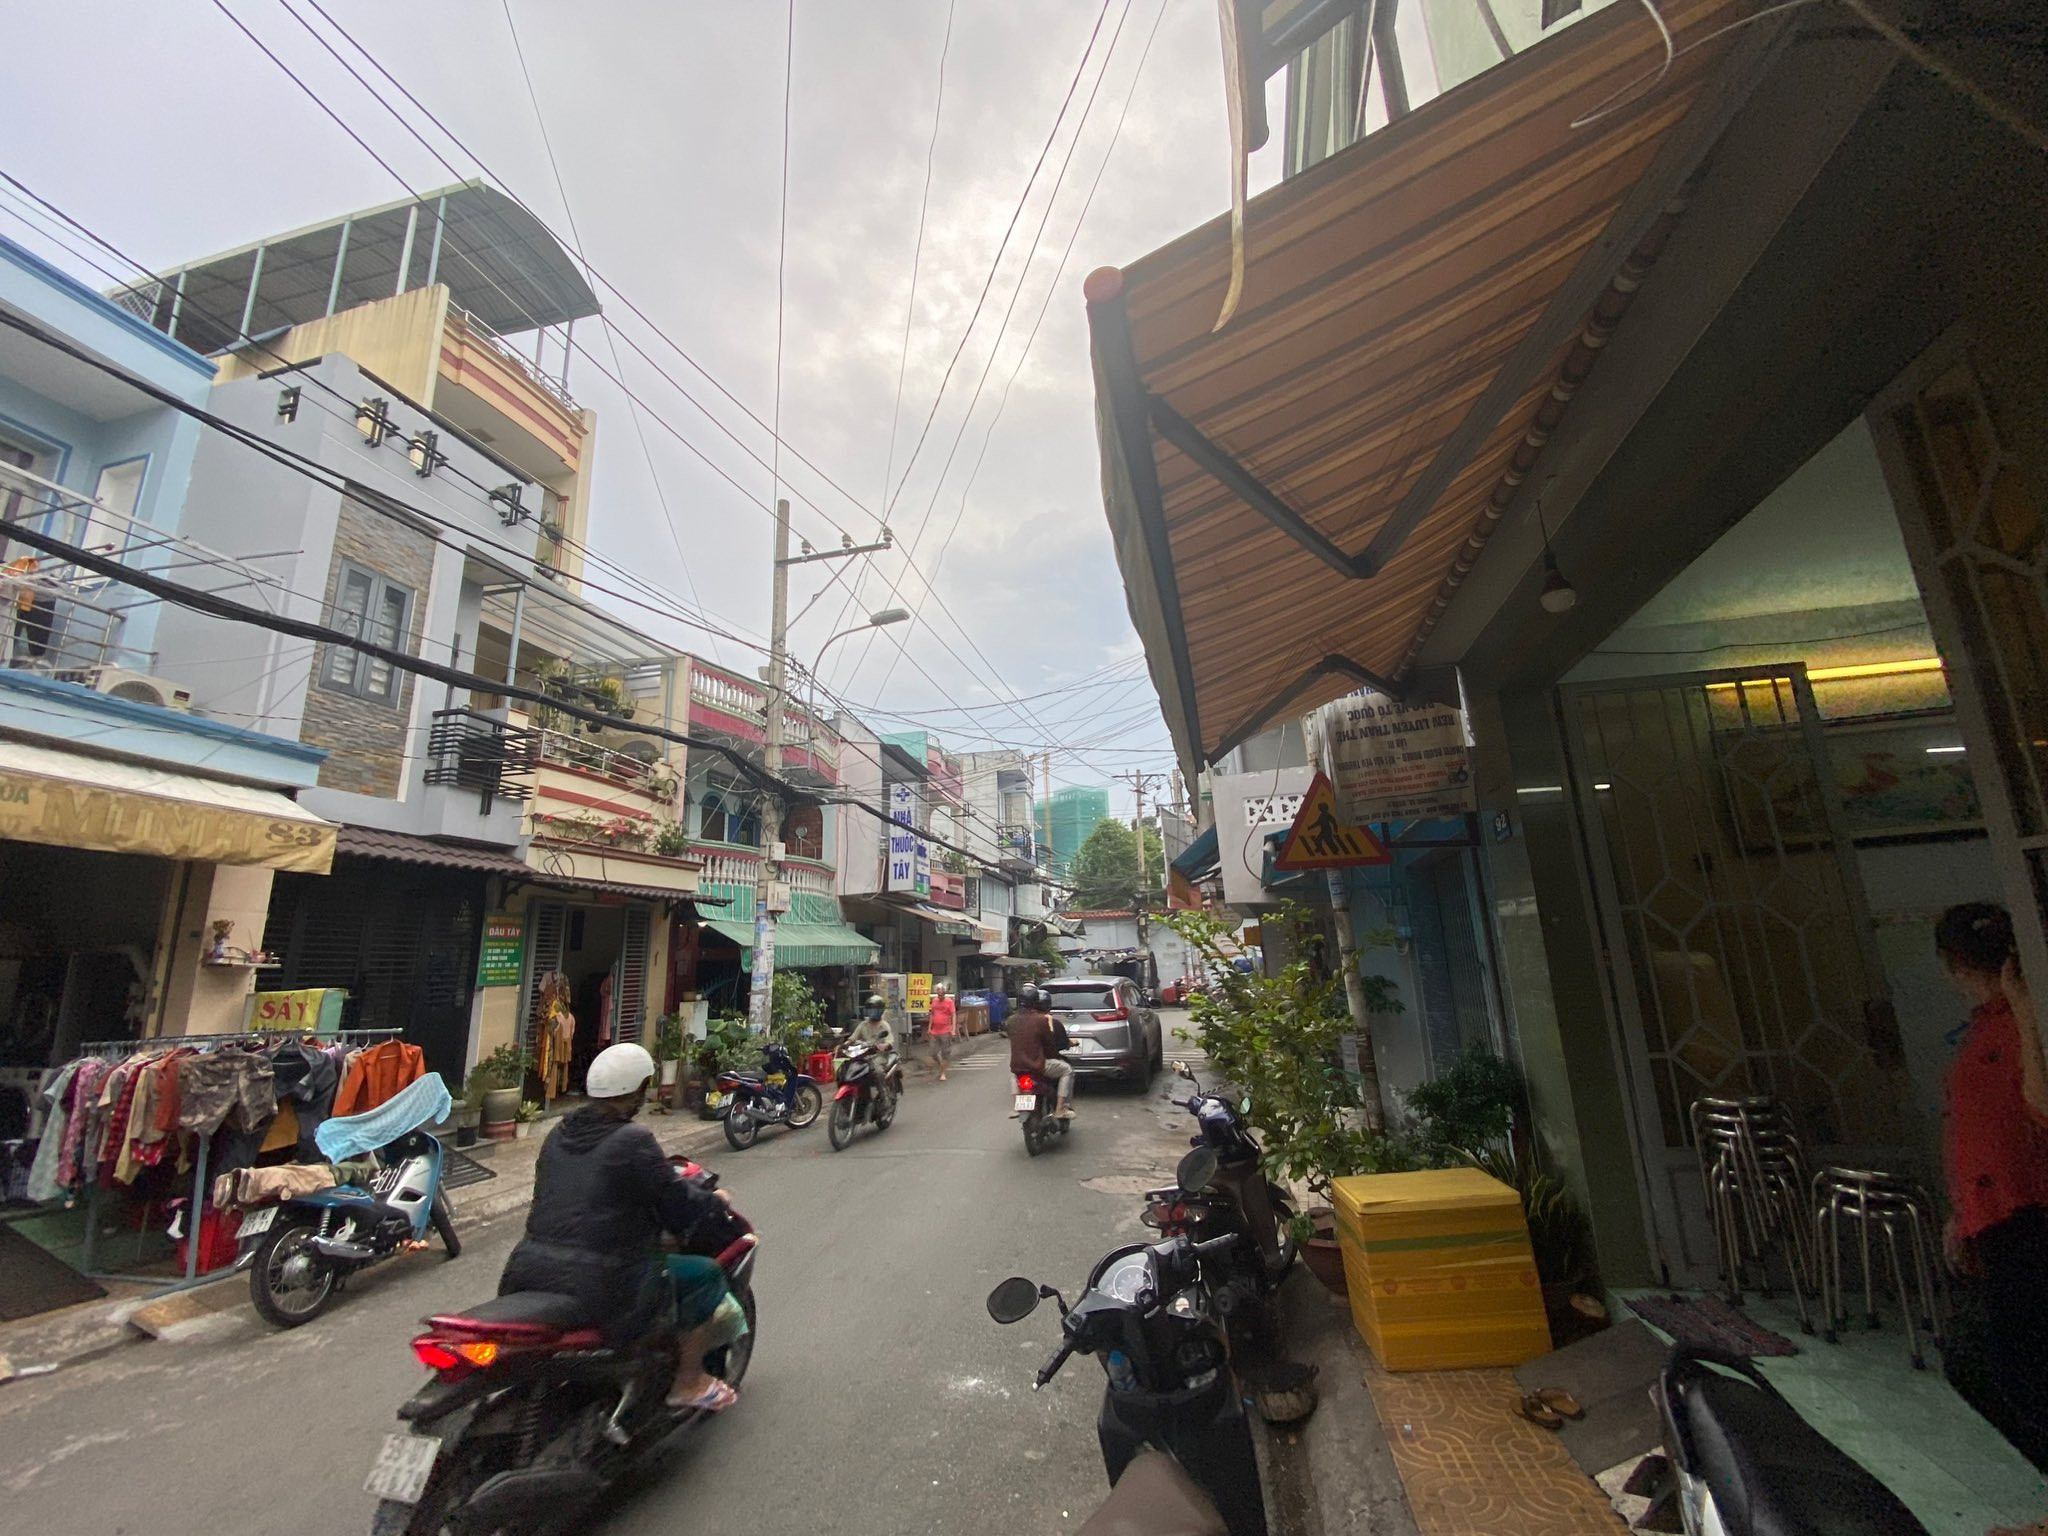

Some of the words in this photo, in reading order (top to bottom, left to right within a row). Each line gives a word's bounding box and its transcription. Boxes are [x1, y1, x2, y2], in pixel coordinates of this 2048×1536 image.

[1496, 813, 1507, 832] 92
[891, 833, 914, 854] THUỐC
[893, 859, 910, 880] TÂY
[260, 993, 309, 1021] SẤY
[911, 999, 925, 1009] 25K
